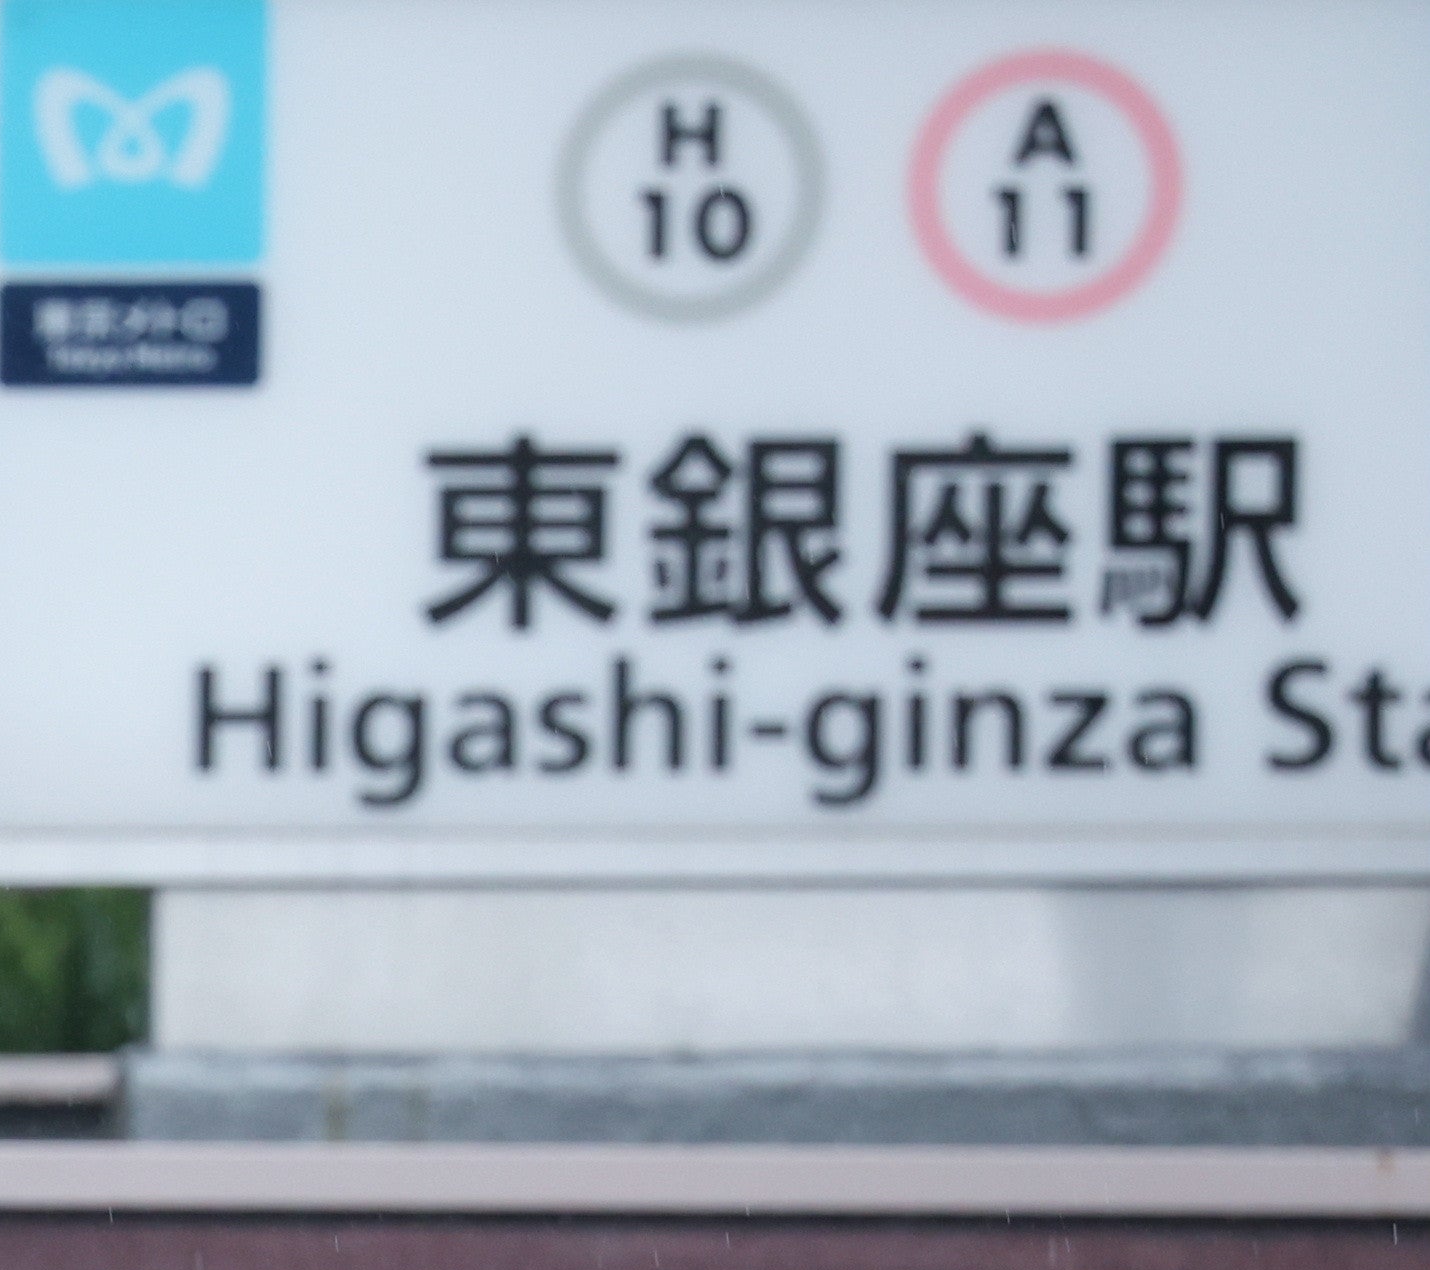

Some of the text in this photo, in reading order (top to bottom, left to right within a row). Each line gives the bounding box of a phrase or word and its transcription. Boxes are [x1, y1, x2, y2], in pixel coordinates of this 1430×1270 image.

[660, 100, 723, 167] H
[1013, 98, 1075, 166] A
[639, 186, 753, 262] 10
[993, 186, 1091, 258] 11
[424, 435, 1303, 630] 東銀座駅
[195, 656, 1430, 809] Higashi-ginza St
